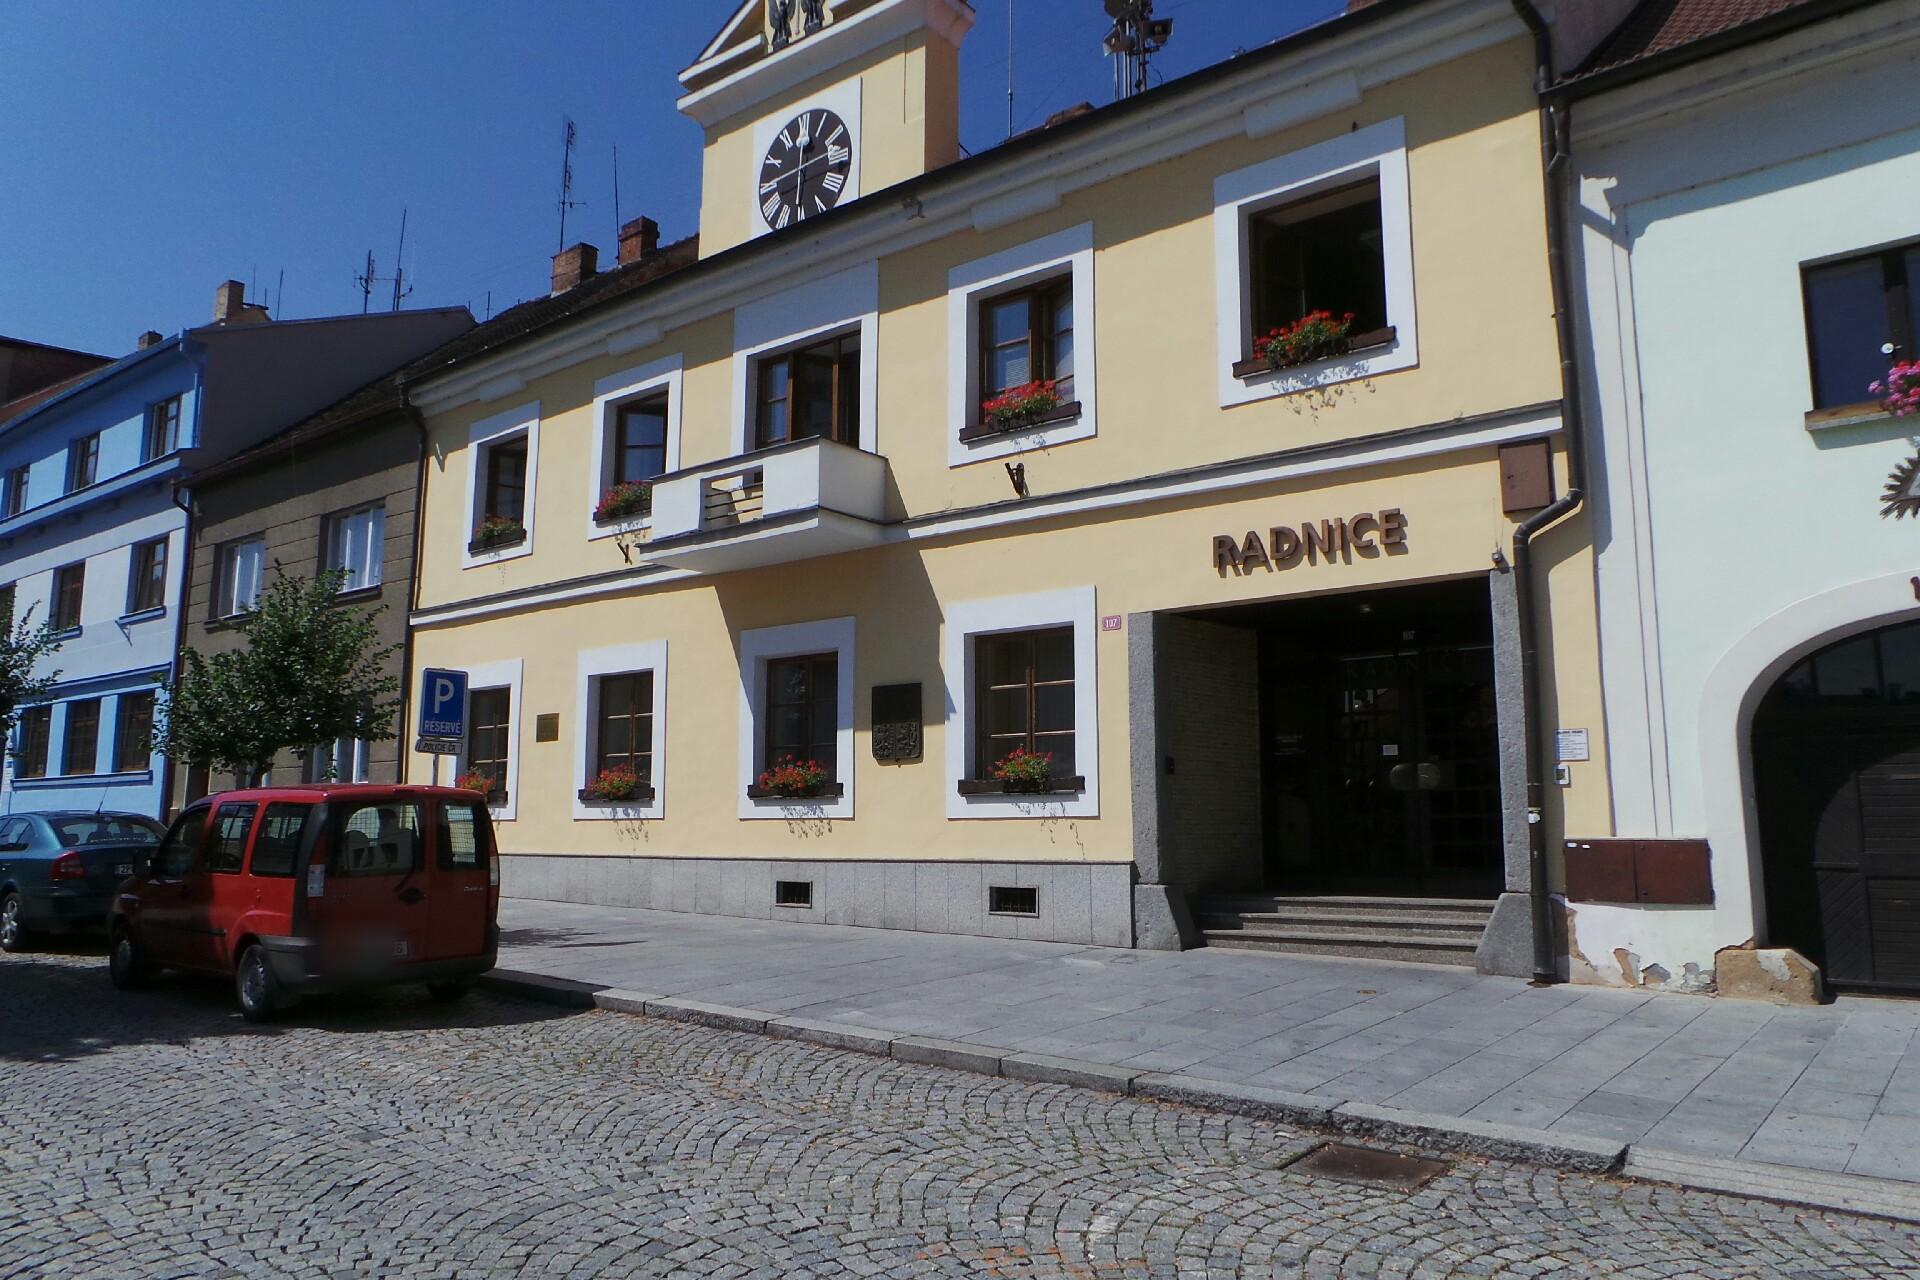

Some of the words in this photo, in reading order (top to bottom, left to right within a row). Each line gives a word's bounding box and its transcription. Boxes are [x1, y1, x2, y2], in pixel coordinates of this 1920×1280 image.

[1213, 508, 1406, 571] RADNICE
[433, 678, 455, 714] P
[423, 742, 446, 752] POLICIE
